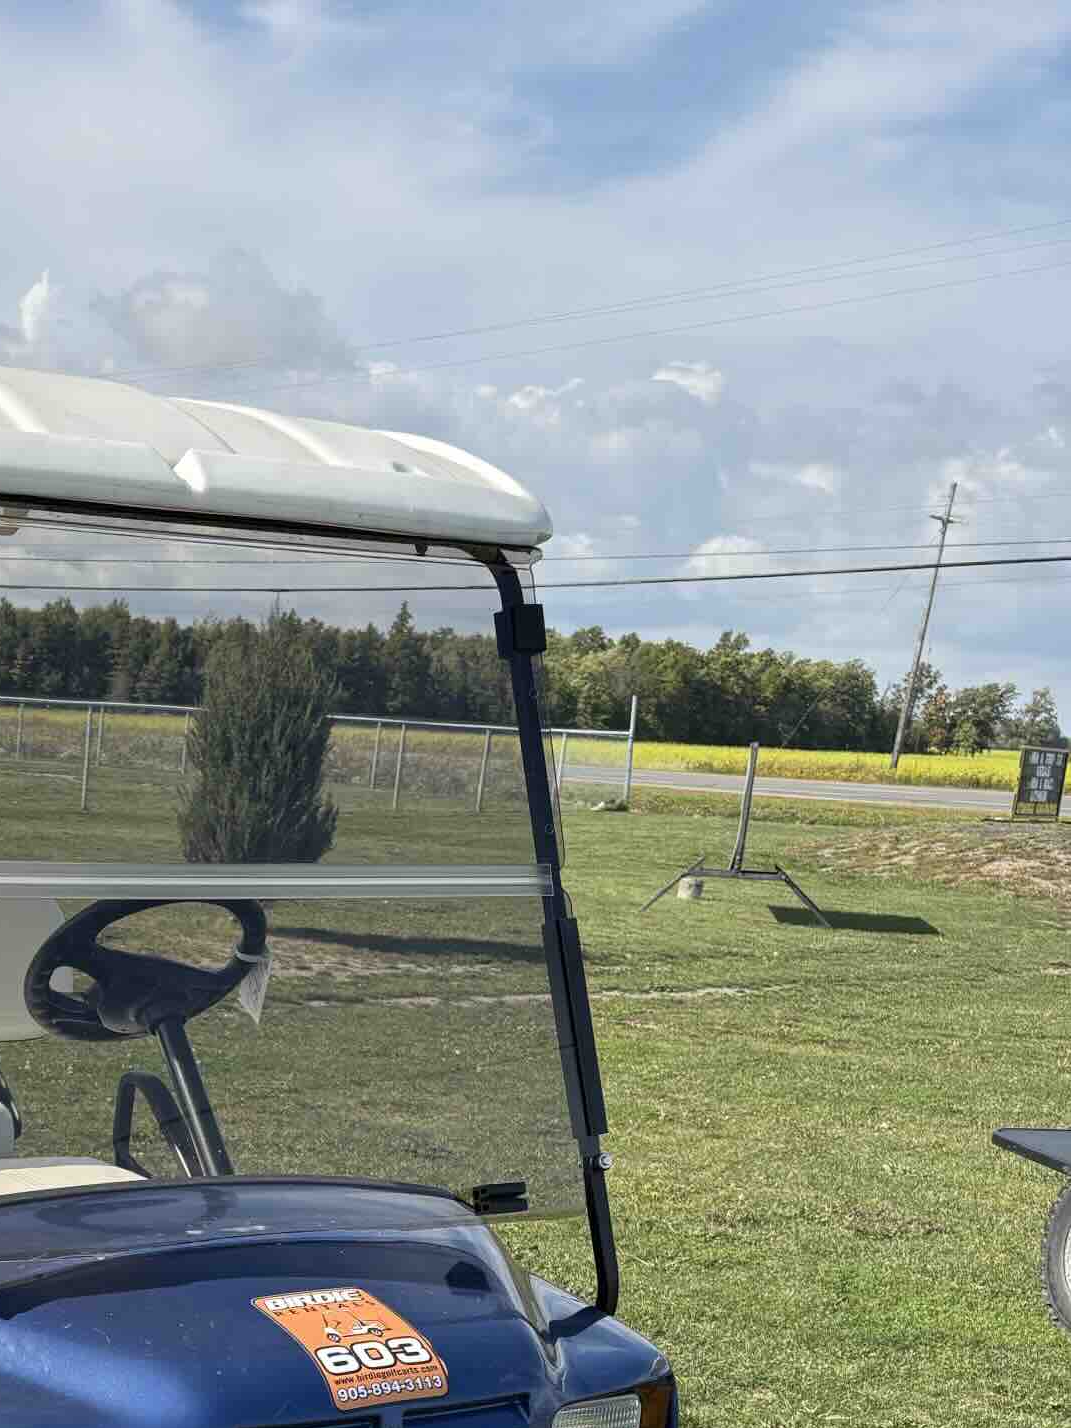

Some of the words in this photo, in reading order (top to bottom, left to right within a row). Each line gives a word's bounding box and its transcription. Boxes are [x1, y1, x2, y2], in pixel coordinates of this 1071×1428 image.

[265, 1288, 362, 1311] BIRDIE
[315, 1335, 432, 1376] 603
[337, 1375, 443, 1402] 905-894-3113
